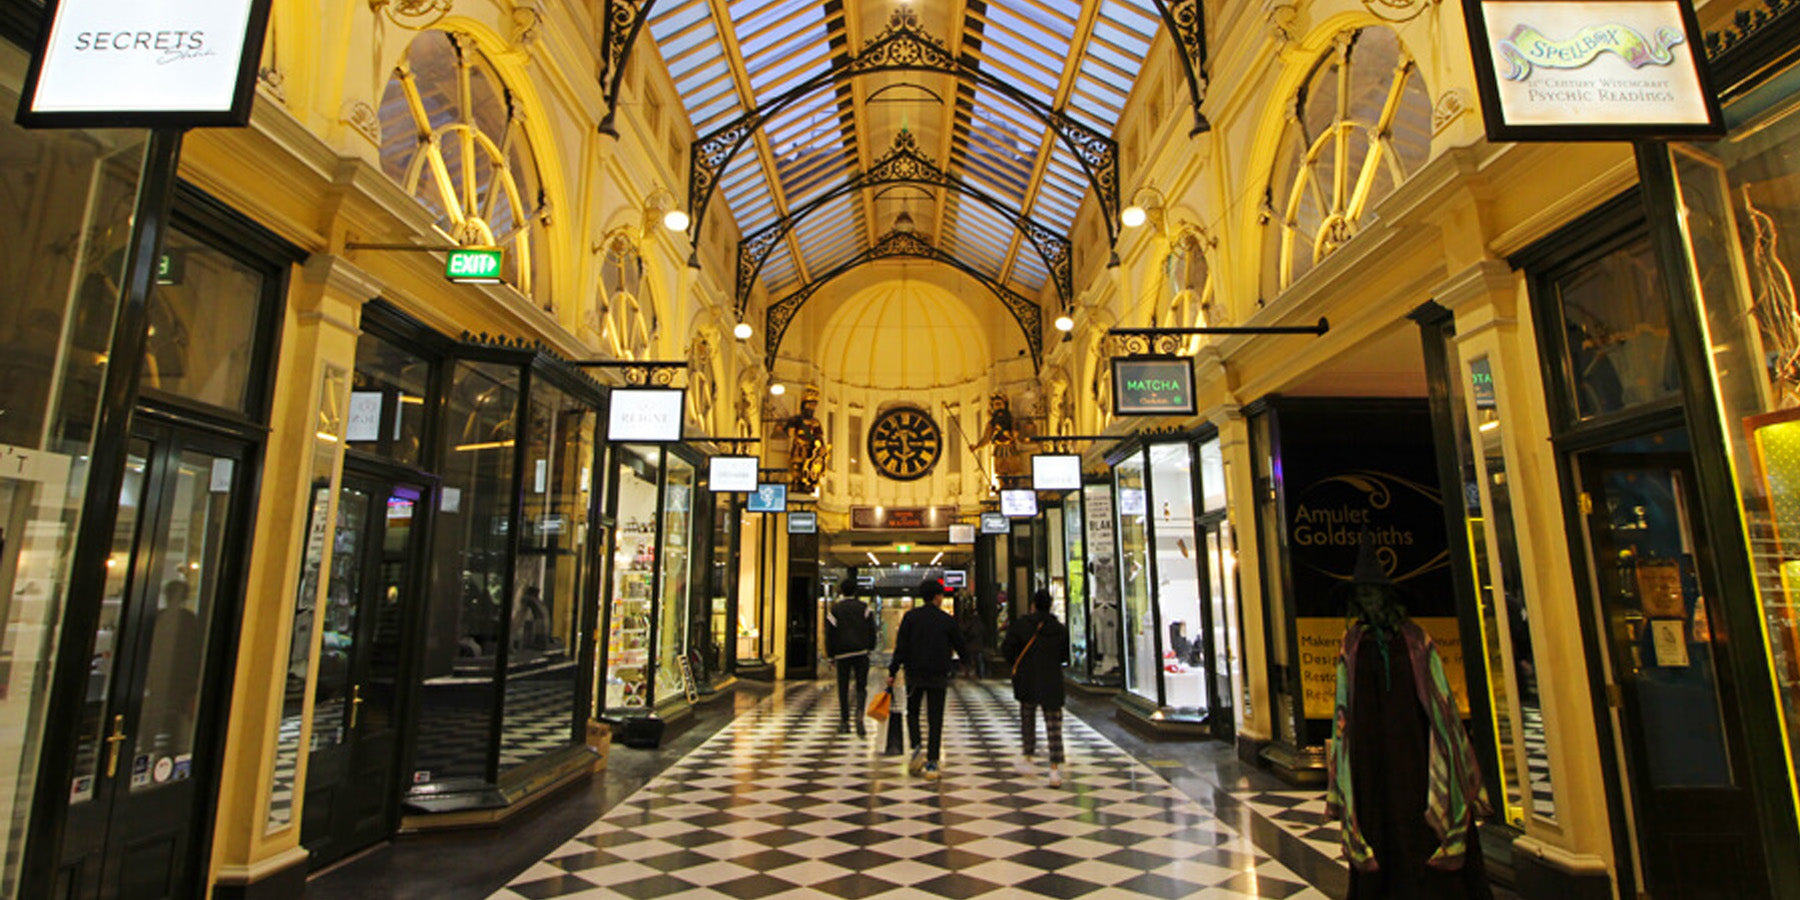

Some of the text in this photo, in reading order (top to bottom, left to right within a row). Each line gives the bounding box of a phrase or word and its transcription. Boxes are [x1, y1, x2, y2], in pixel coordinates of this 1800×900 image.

[75, 31, 204, 50] SECRETS
[450, 254, 488, 273] EXIT
[1127, 379, 1180, 391] MATCHA
[1295, 504, 1371, 524] Amulet
